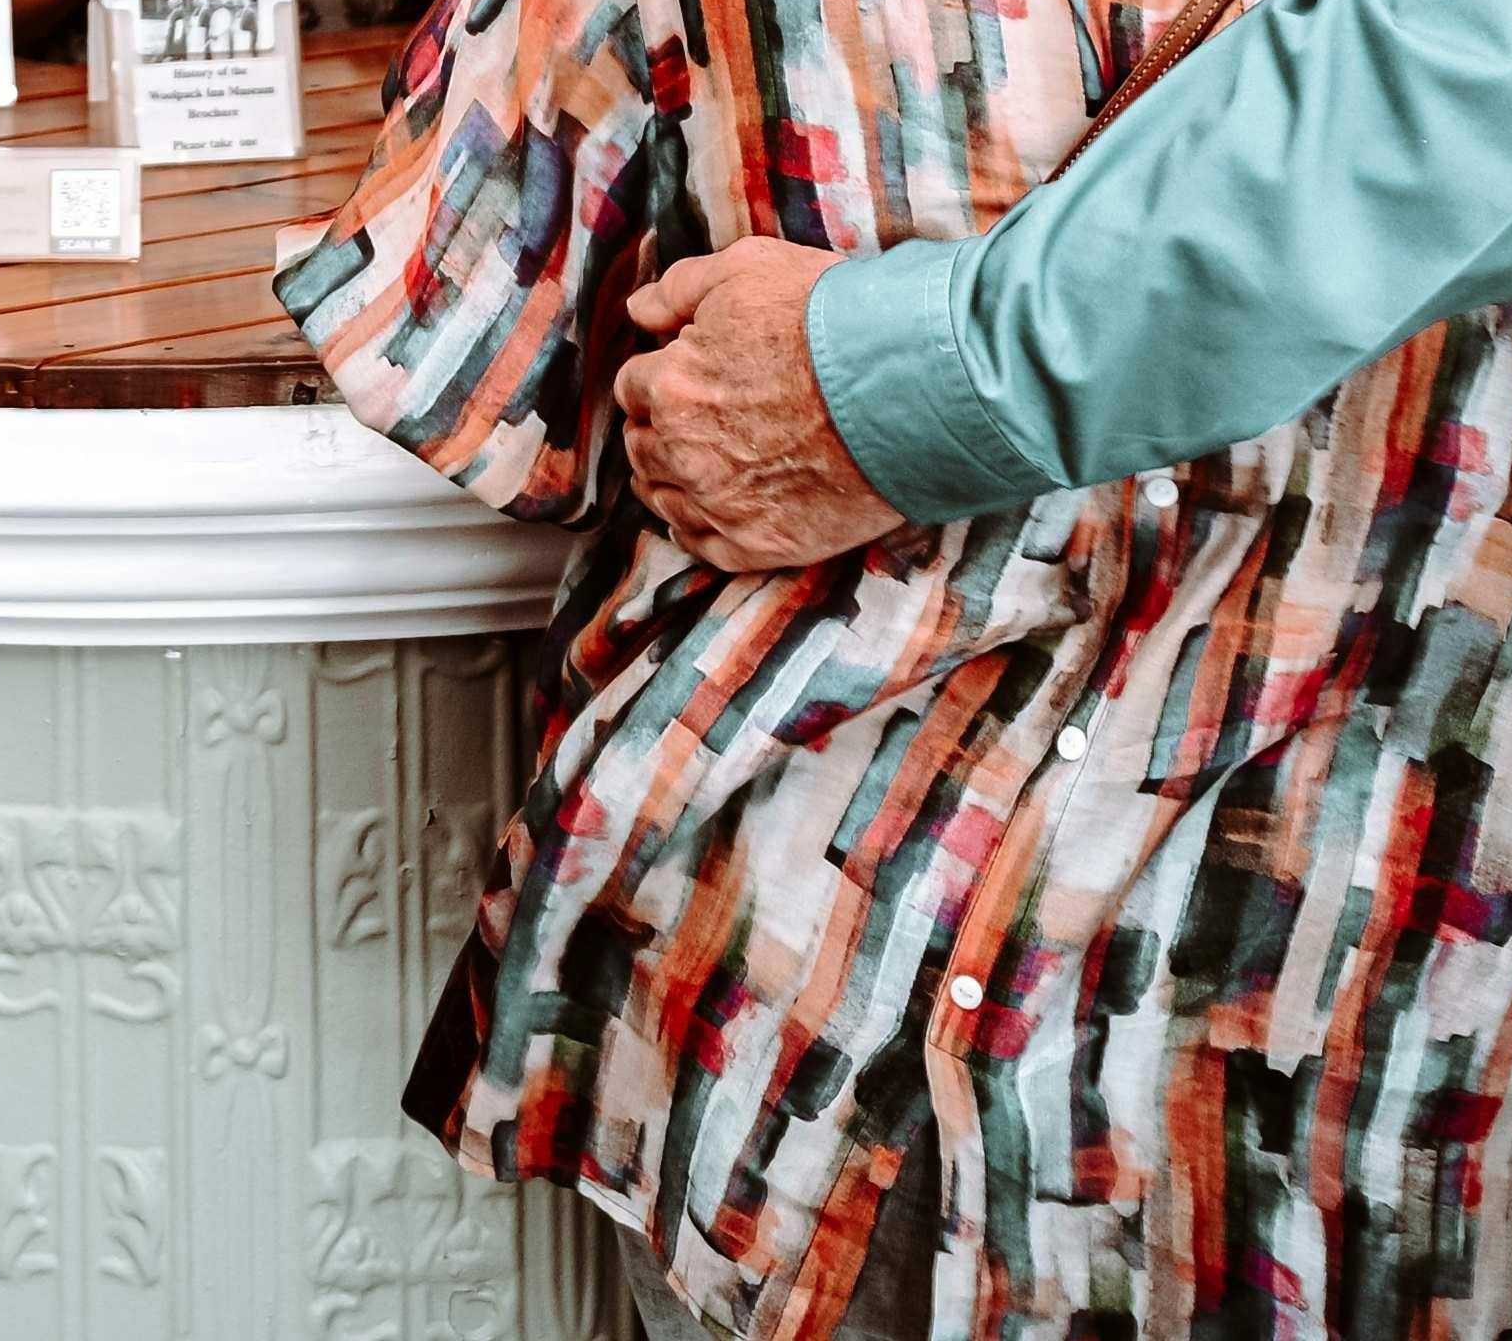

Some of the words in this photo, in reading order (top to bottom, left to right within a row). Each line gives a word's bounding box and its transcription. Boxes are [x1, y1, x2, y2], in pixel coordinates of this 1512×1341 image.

[173, 67, 213, 79] History
[148, 89, 203, 101] Woolpack
[173, 139, 207, 150] Please
